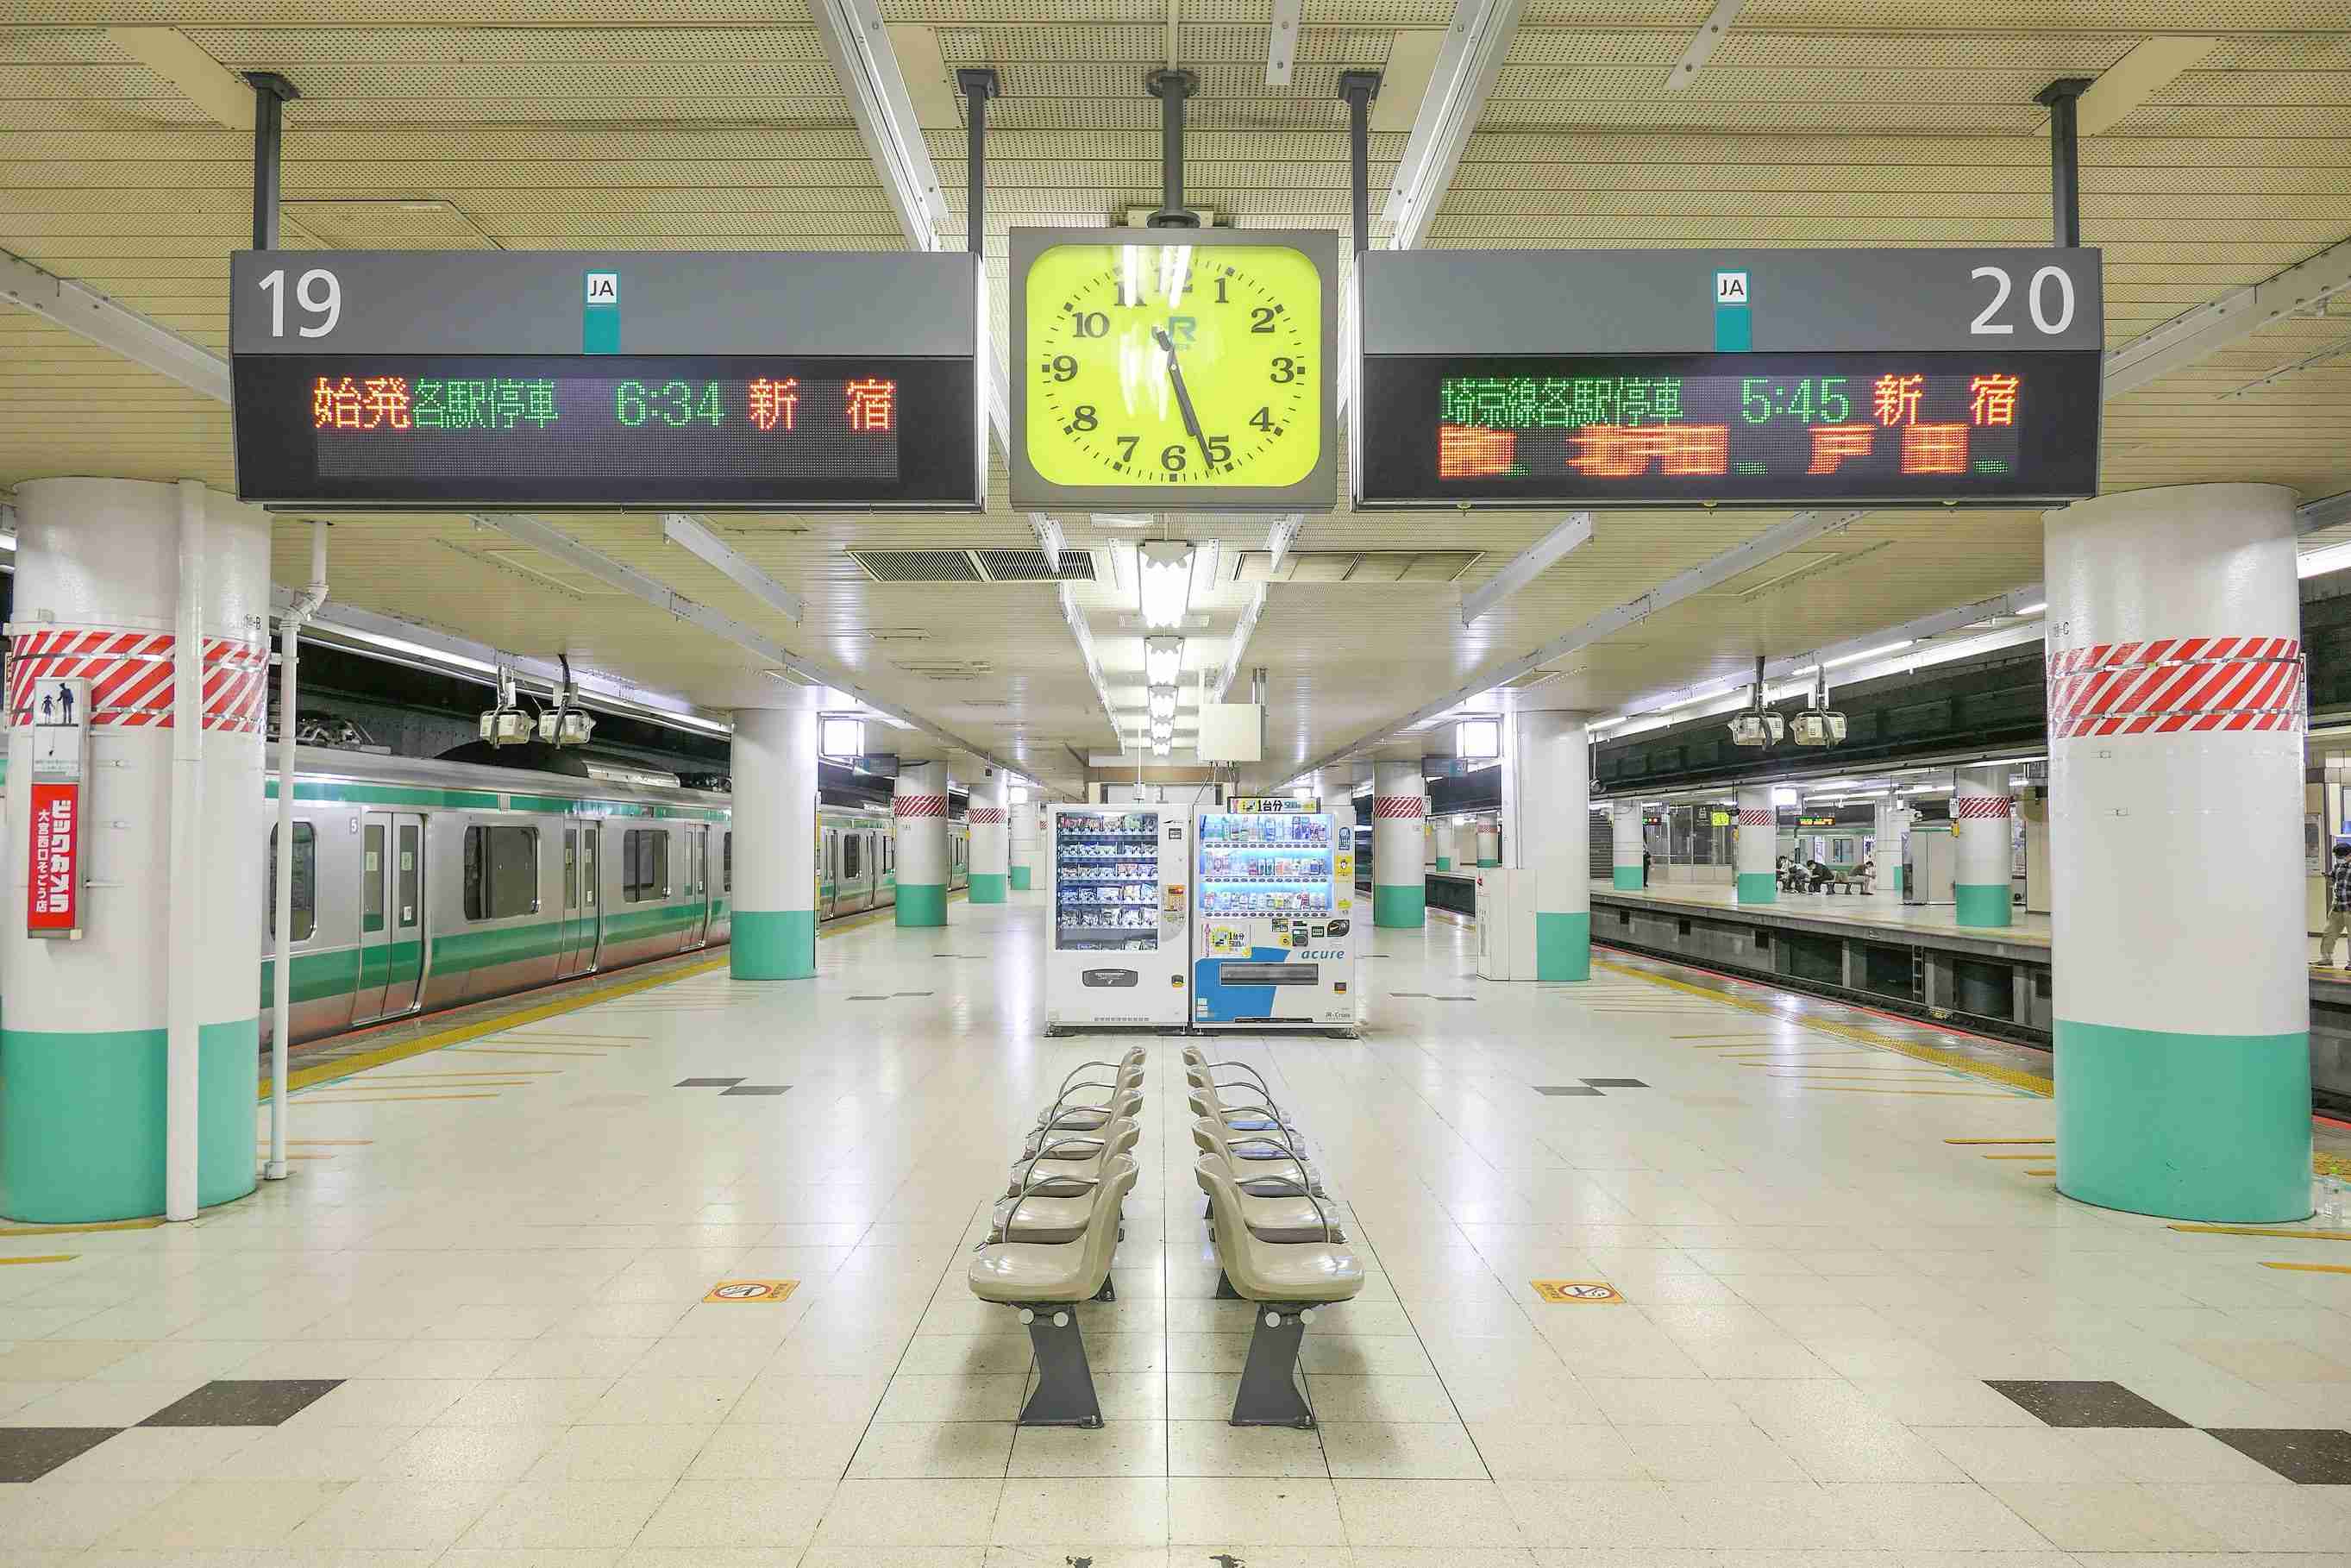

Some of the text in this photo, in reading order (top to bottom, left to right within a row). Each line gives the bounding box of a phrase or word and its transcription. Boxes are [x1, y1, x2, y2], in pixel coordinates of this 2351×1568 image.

[590, 280, 613, 297] JA
[1214, 278, 1229, 303] 1
[1720, 279, 1745, 297] JA
[1969, 267, 2076, 335] 20
[255, 269, 342, 338] 19
[1072, 312, 1110, 338] 10
[1251, 308, 1276, 333] 2
[1052, 355, 1078, 381] 9
[1270, 357, 1294, 383] 3
[615, 380, 724, 428] 6:34
[1741, 377, 1850, 424] 5:45
[1072, 405, 1098, 431] 8
[1249, 407, 1275, 432] 4
[1117, 436, 1140, 462] 7
[1161, 445, 1186, 471] 6
[1207, 436, 1232, 461] 5
[1301, 950, 1345, 959] acure
